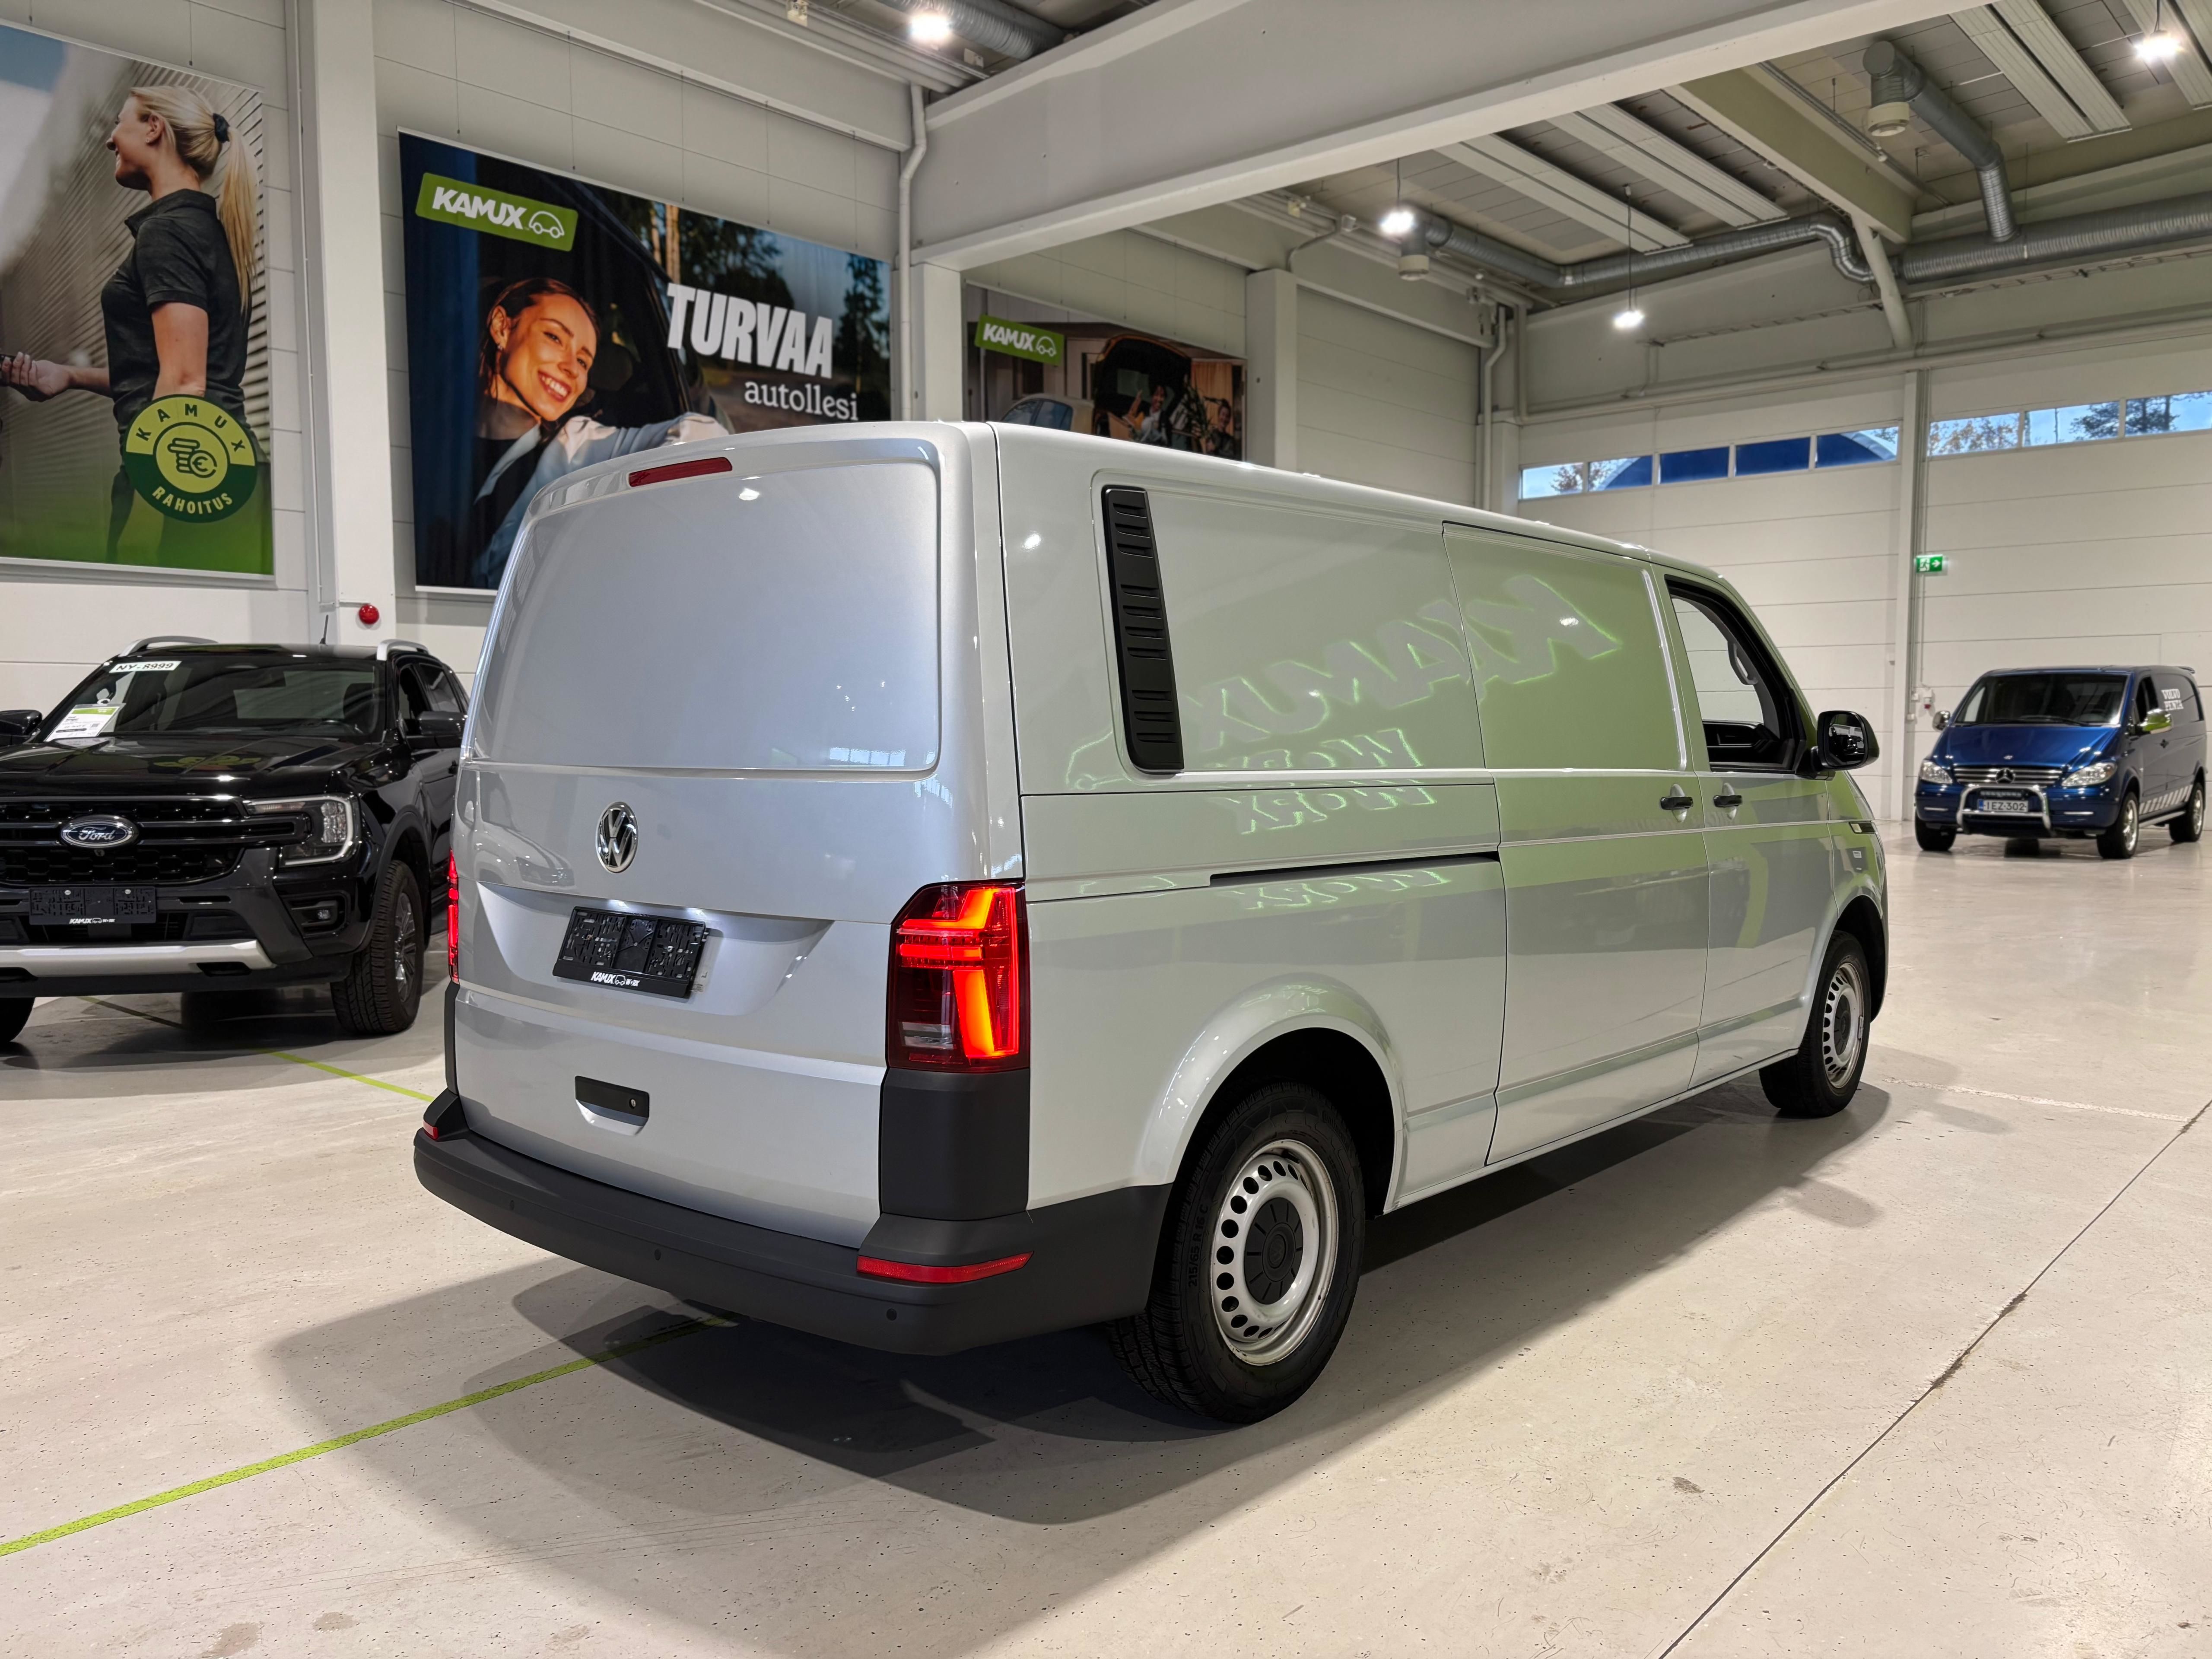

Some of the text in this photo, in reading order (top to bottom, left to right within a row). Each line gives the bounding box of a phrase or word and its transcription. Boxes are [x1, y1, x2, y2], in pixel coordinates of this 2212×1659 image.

[432, 186, 527, 229] KAMUX
[667, 282, 833, 379] TURVAA
[982, 323, 1036, 352] KAMUX
[744, 381, 858, 420] autollesi
[135, 403, 245, 452] KAMUX
[152, 486, 232, 514] RAHOITUS
[1987, 801, 2025, 810] IEZ-302
[78, 826, 116, 840] Ford
[591, 971, 616, 984] KAMUX
[1188, 1204, 1208, 1287] 215/65 R 16 C
